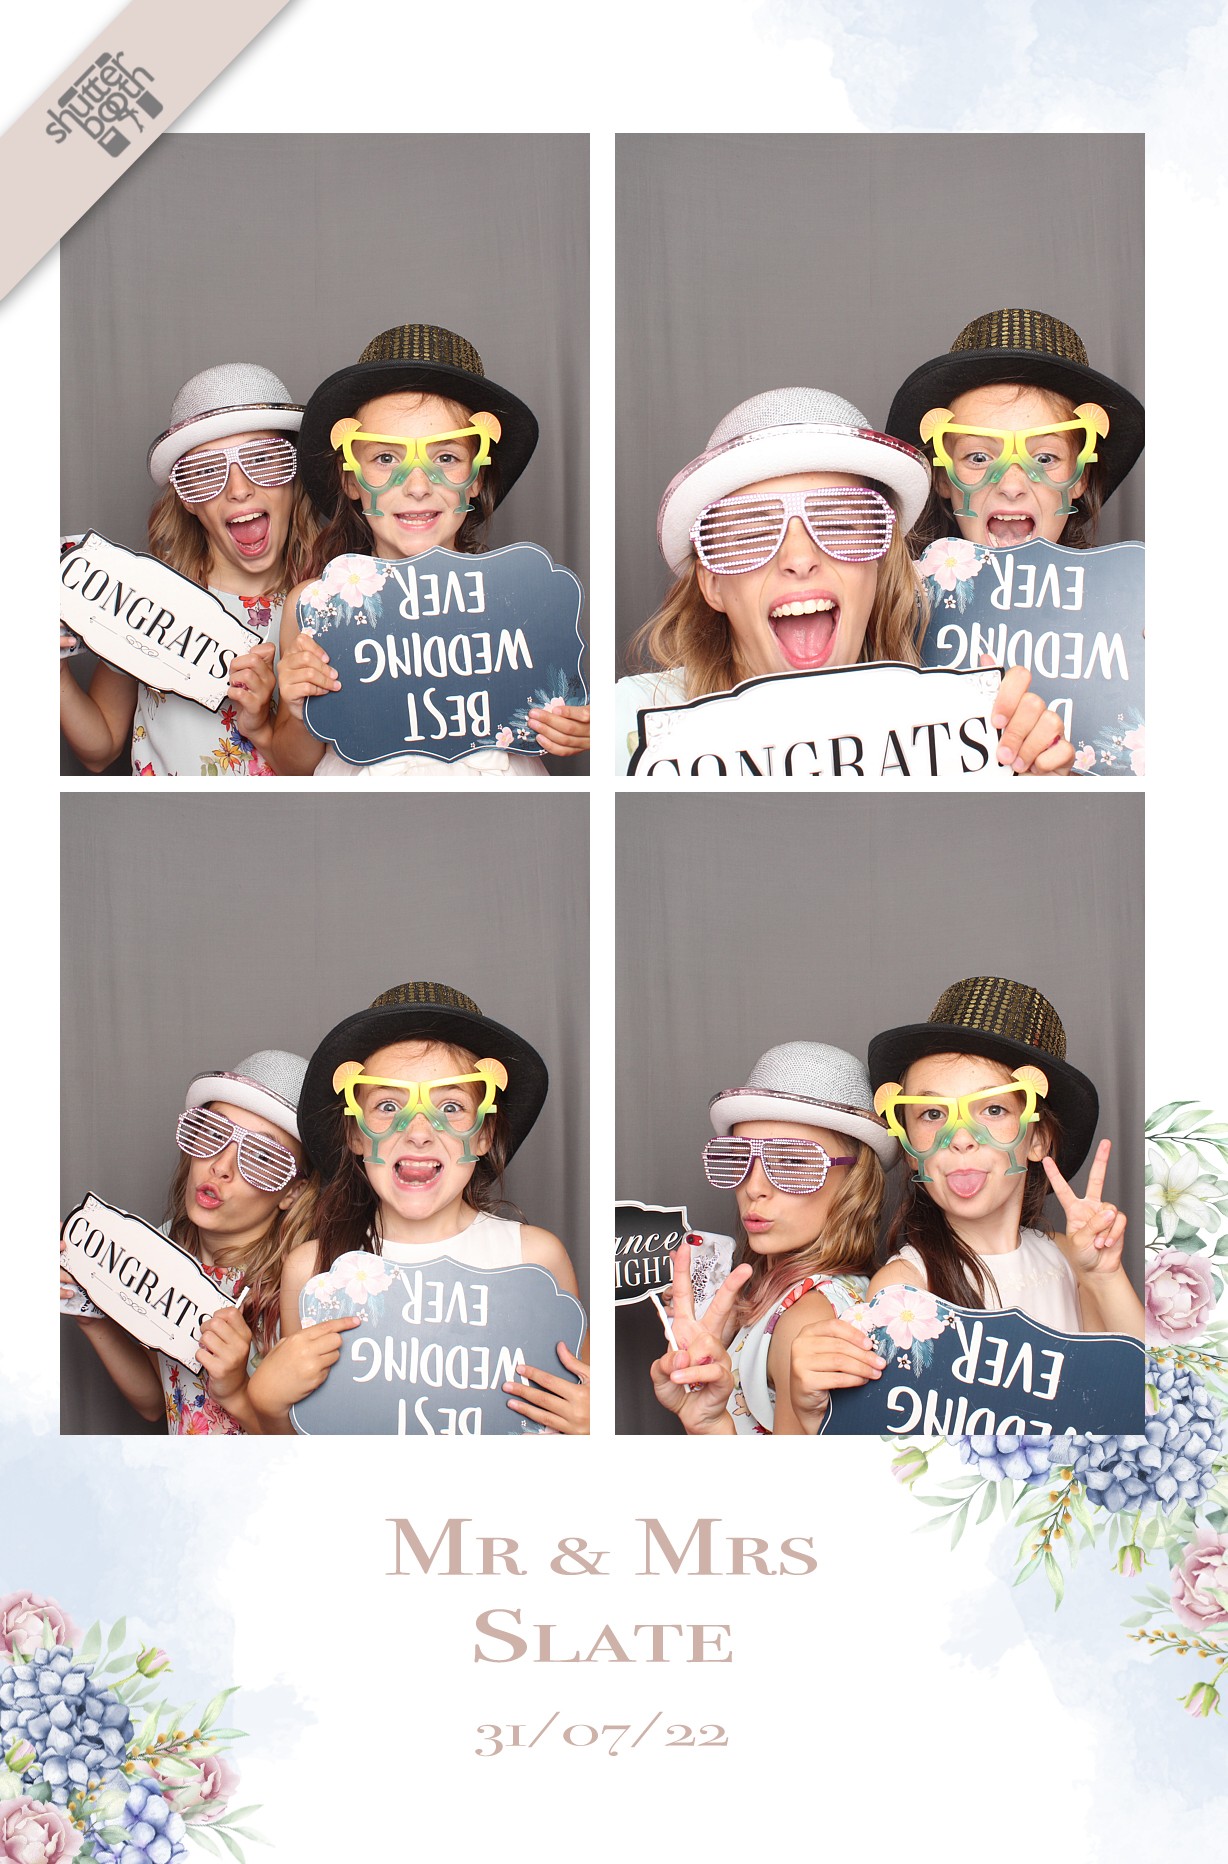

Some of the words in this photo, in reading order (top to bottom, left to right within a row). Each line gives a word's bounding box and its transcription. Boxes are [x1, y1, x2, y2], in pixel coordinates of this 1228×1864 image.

[392, 565, 486, 620] EVER
[990, 553, 1085, 611] EVER
[354, 628, 534, 683] WEDDING
[936, 621, 1130, 681] WEDDING
[403, 687, 491, 742] BEST
[400, 1270, 489, 1327] EVER
[351, 1335, 530, 1390] WEDDING
[951, 1320, 1065, 1400] EVER
